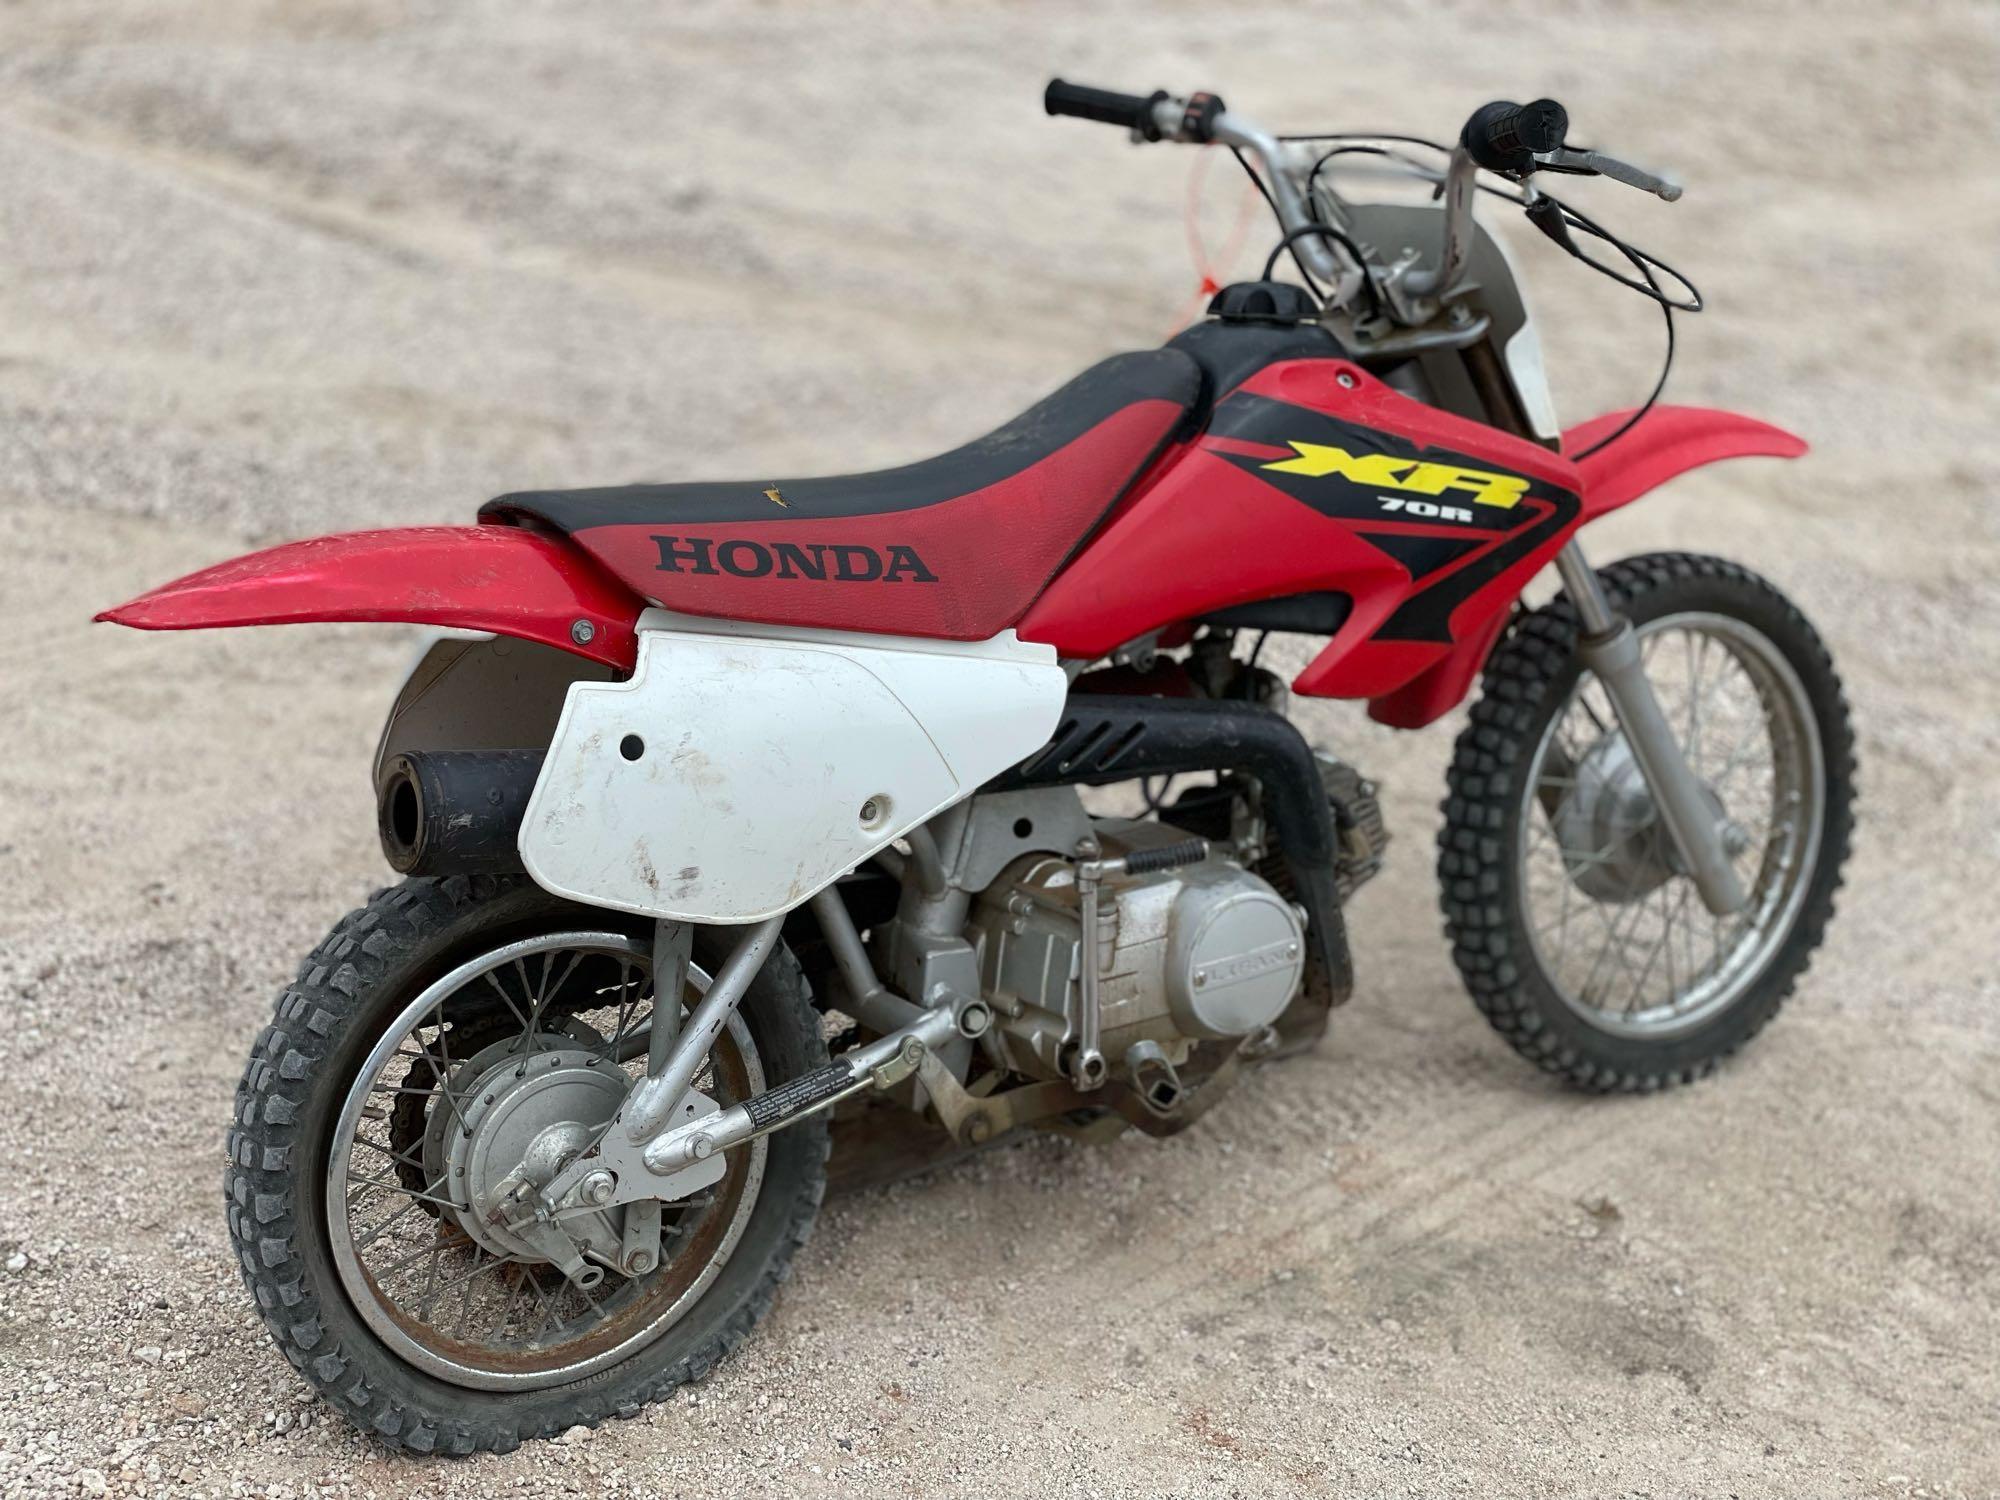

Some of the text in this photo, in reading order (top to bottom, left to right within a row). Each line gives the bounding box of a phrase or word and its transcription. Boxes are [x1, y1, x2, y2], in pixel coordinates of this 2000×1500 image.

[1259, 440, 1531, 509] XR
[1377, 496, 1473, 522] 70R
[650, 535, 939, 583] HONDA
